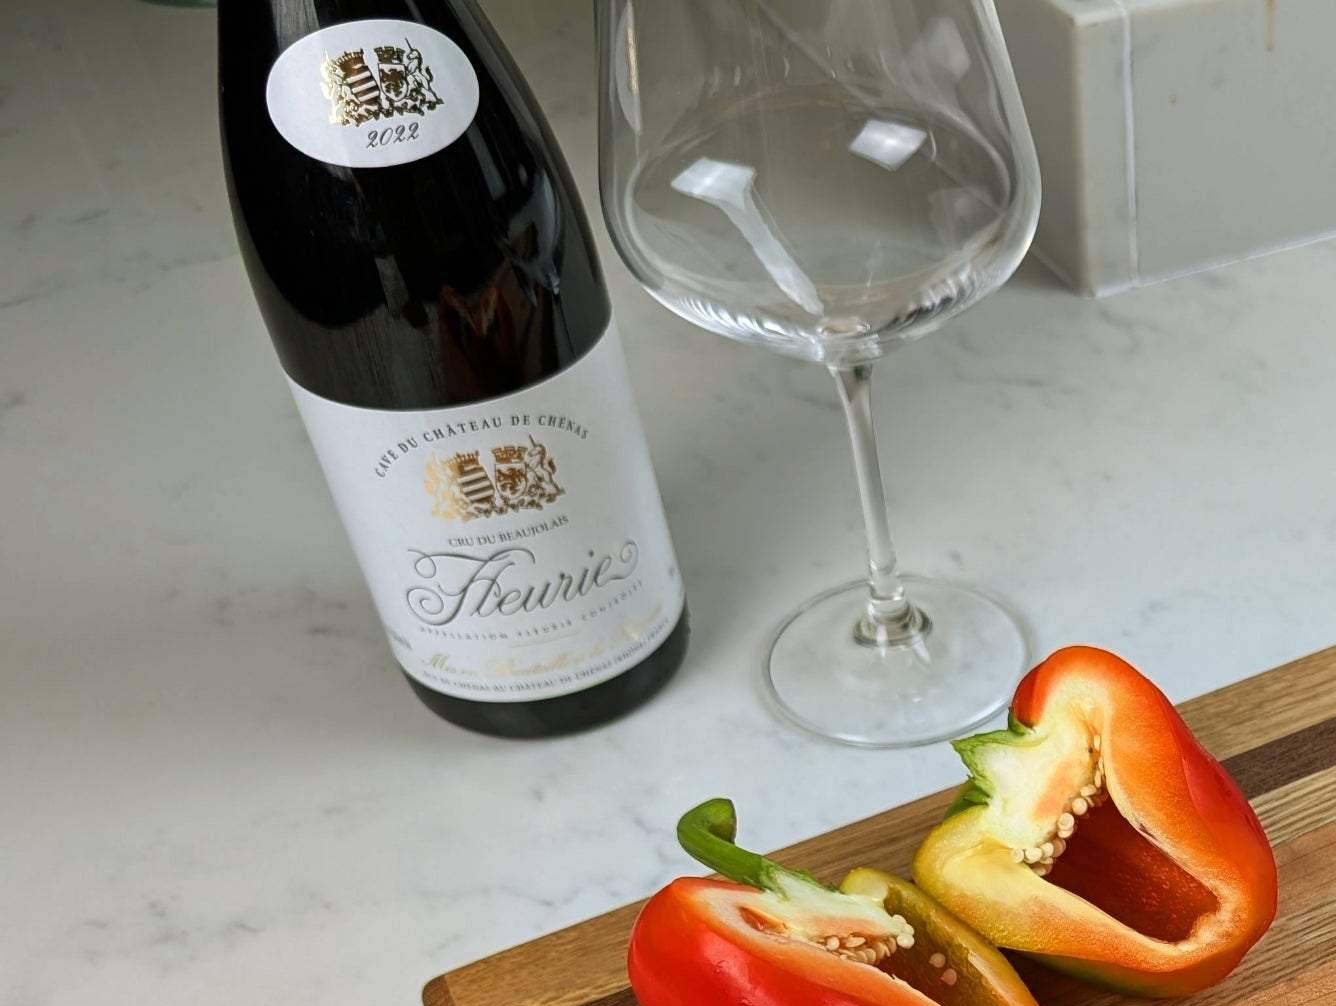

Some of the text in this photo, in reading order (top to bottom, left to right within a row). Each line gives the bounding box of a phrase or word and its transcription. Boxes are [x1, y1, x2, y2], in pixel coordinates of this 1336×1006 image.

[366, 122, 420, 149] 2022
[375, 449, 399, 478] CAVE
[397, 437, 419, 454] DU
[423, 416, 503, 443] CHÂTEAU
[511, 414, 531, 427] DE
[448, 514, 569, 548] CRU DU BEAUJOLAIS
[406, 539, 640, 626] Fleurie
